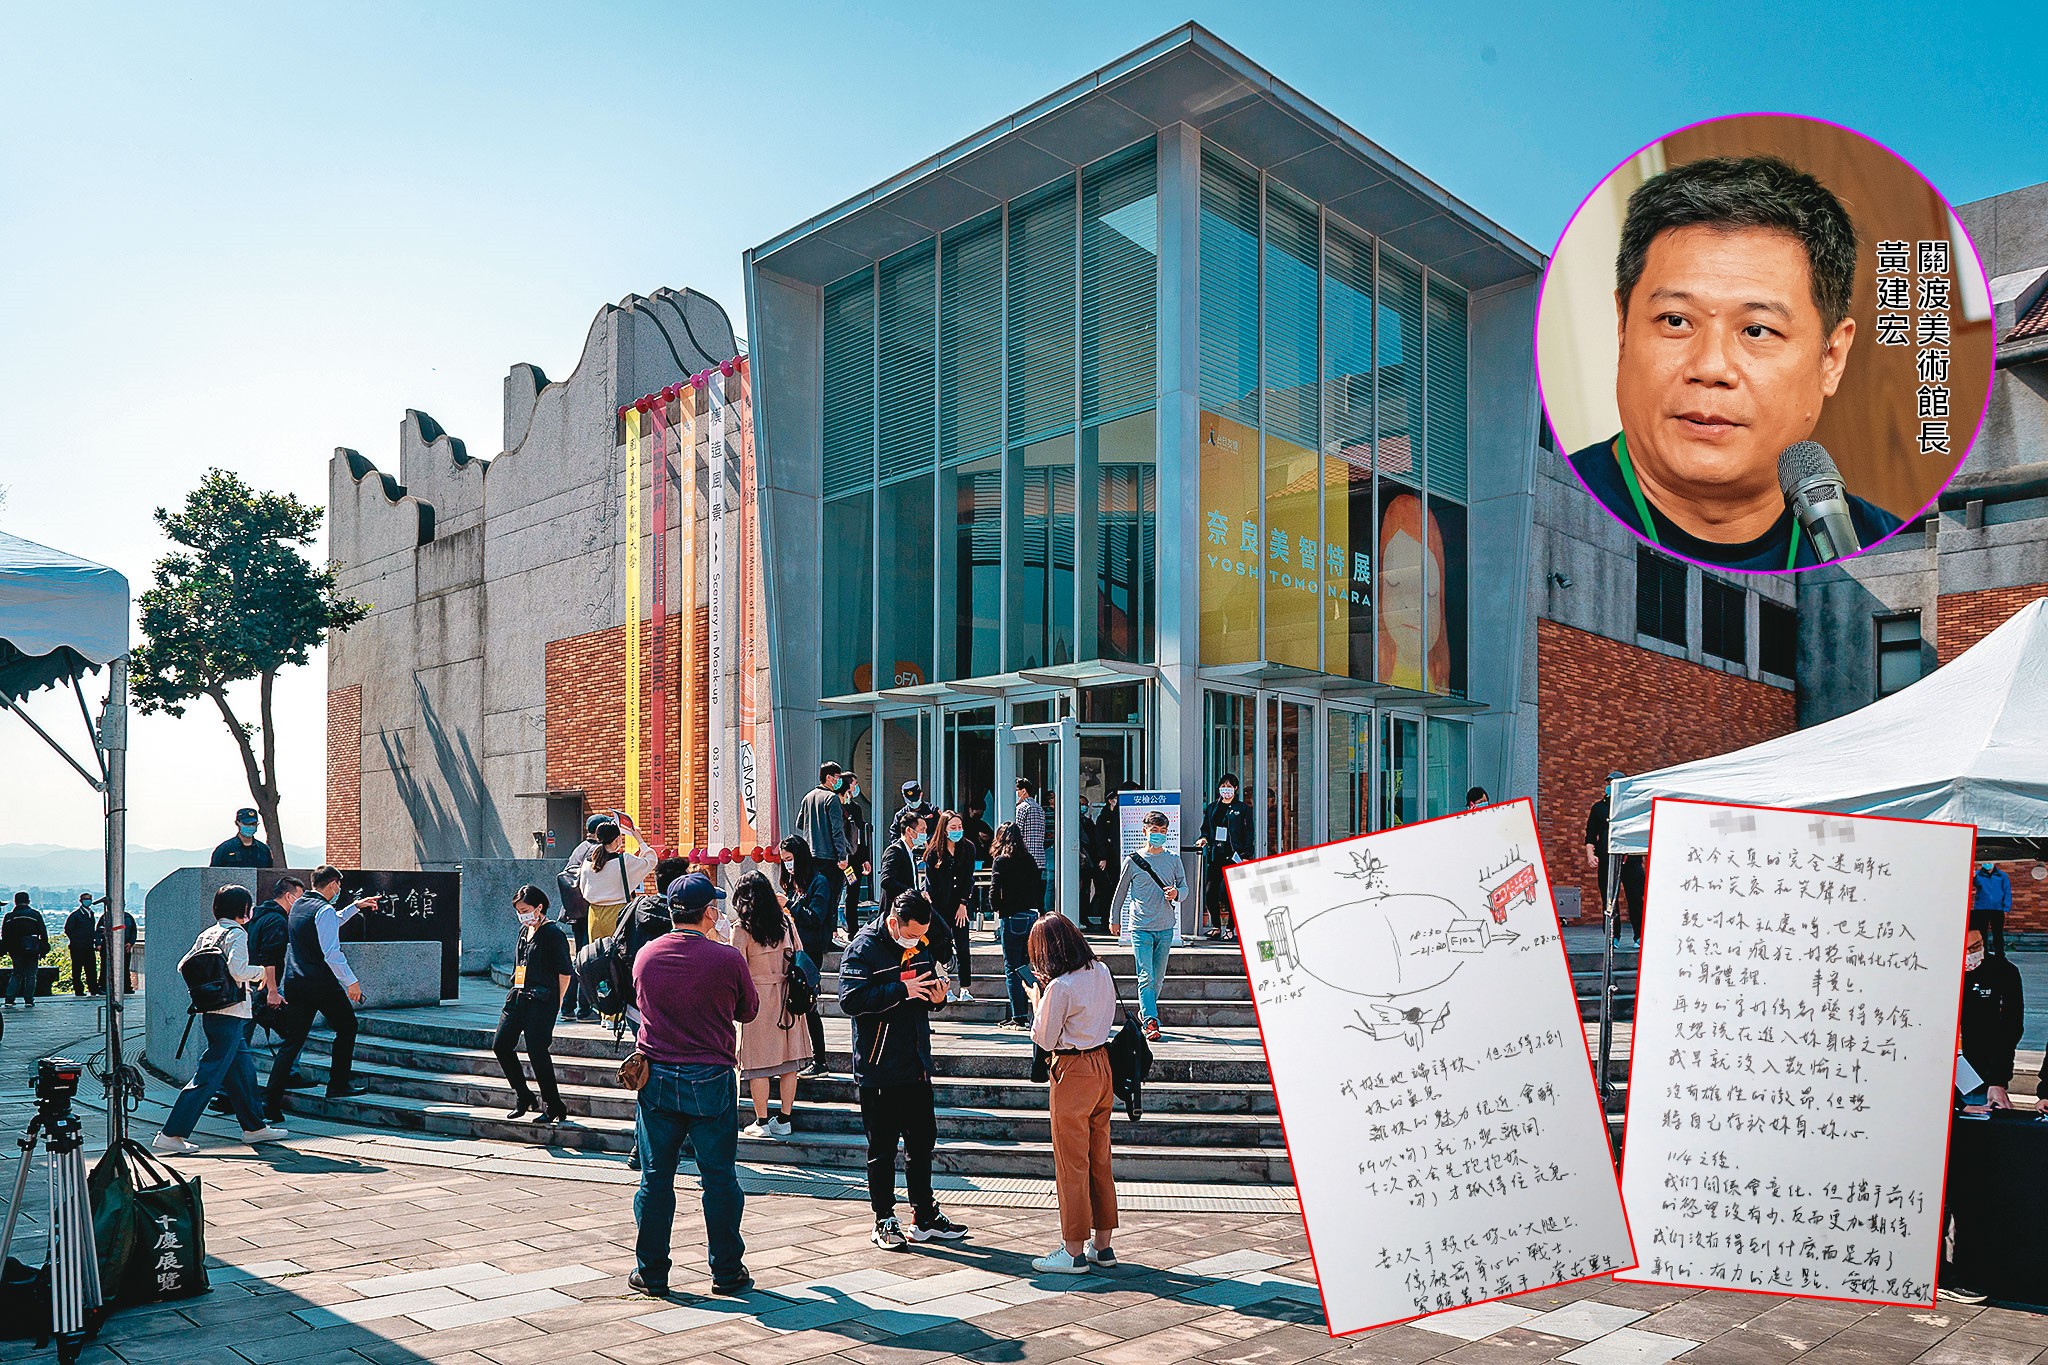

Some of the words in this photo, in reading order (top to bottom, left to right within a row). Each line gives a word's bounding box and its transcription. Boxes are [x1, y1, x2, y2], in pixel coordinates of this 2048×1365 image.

[1207, 510, 1371, 585] 奈良美智特展
[711, 573, 721, 625] Scenery
[1207, 553, 1318, 594] YOSHTOMO
[1328, 585, 1371, 607] NARA
[652, 625, 665, 694] PROVOKE
[712, 630, 721, 642] in
[711, 647, 721, 705] Mock-up
[1133, 794, 1167, 804] 安檢公告
